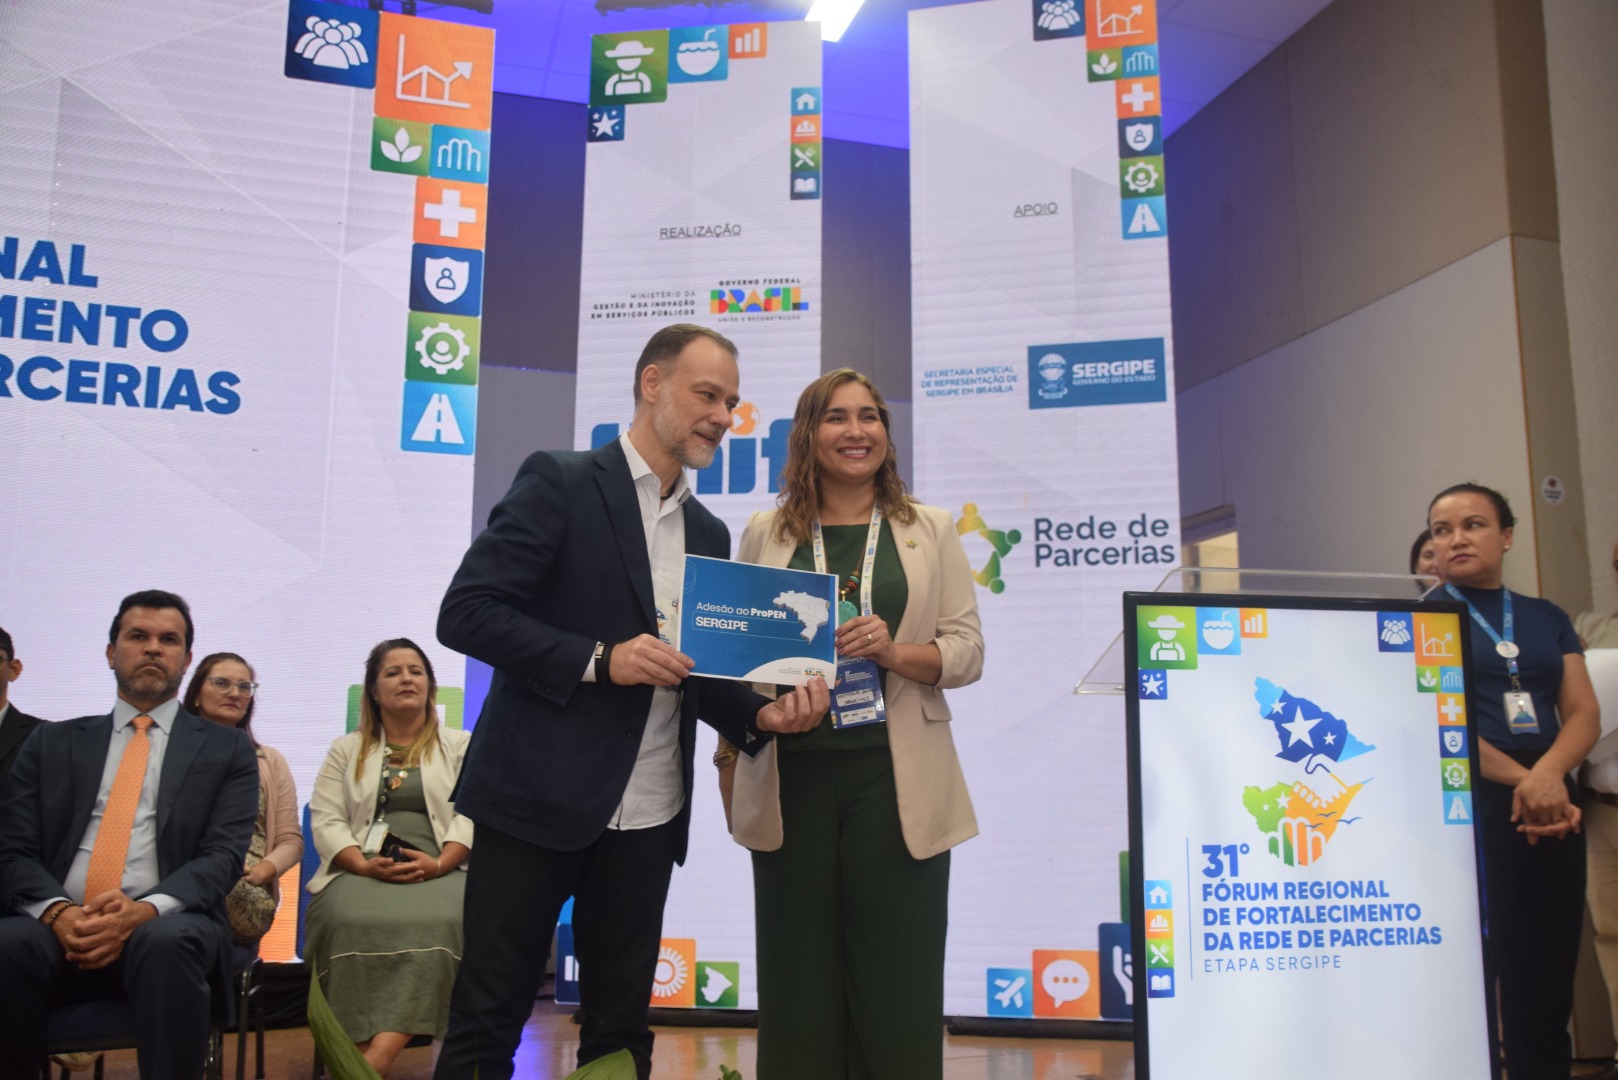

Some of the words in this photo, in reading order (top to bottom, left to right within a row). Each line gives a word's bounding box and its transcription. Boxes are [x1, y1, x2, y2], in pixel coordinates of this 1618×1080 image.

[1014, 202, 1058, 217] APOIO
[659, 223, 742, 239] REALIZAÇÃO
[719, 279, 760, 287] GOVERNO
[763, 277, 801, 285] FEDERAL
[631, 291, 681, 299] MINISTÉRIO
[710, 286, 809, 314] BRASIL
[593, 302, 626, 310] GESTÃO
[651, 299, 695, 307] INOVAÇÃO
[606, 311, 648, 319] SERVIÇOS
[651, 309, 695, 317] PÚBLICOS
[976, 365, 1014, 375] ESPECIAL
[1072, 359, 1156, 378] SERGIPE
[921, 380, 932, 388] DE
[1006, 374, 1018, 382] DE
[1072, 377, 1110, 386] GOVERNO
[1111, 376, 1122, 384] DO
[1124, 375, 1156, 383] ESTADO
[1034, 515, 1117, 542] Rede
[1128, 513, 1169, 538] de
[1035, 539, 1175, 568] Parcerias
[696, 602, 734, 615] Adesão
[735, 606, 749, 616] ao
[750, 607, 787, 620] ProPEN
[695, 616, 748, 632] SERGIPE
[1202, 878, 1278, 901] FÓRUM
[1284, 880, 1389, 900] REGIONAL
[1203, 908, 1231, 926] DE
[1236, 903, 1421, 926] FORTALECIMENTO
[1204, 932, 1234, 951] DA
[1239, 930, 1293, 950] REDE
[1298, 930, 1325, 949] DE
[1330, 926, 1442, 947] PARCERIAS
[1204, 957, 1259, 973] ETAPA
[1266, 955, 1341, 971] SERGIPE
